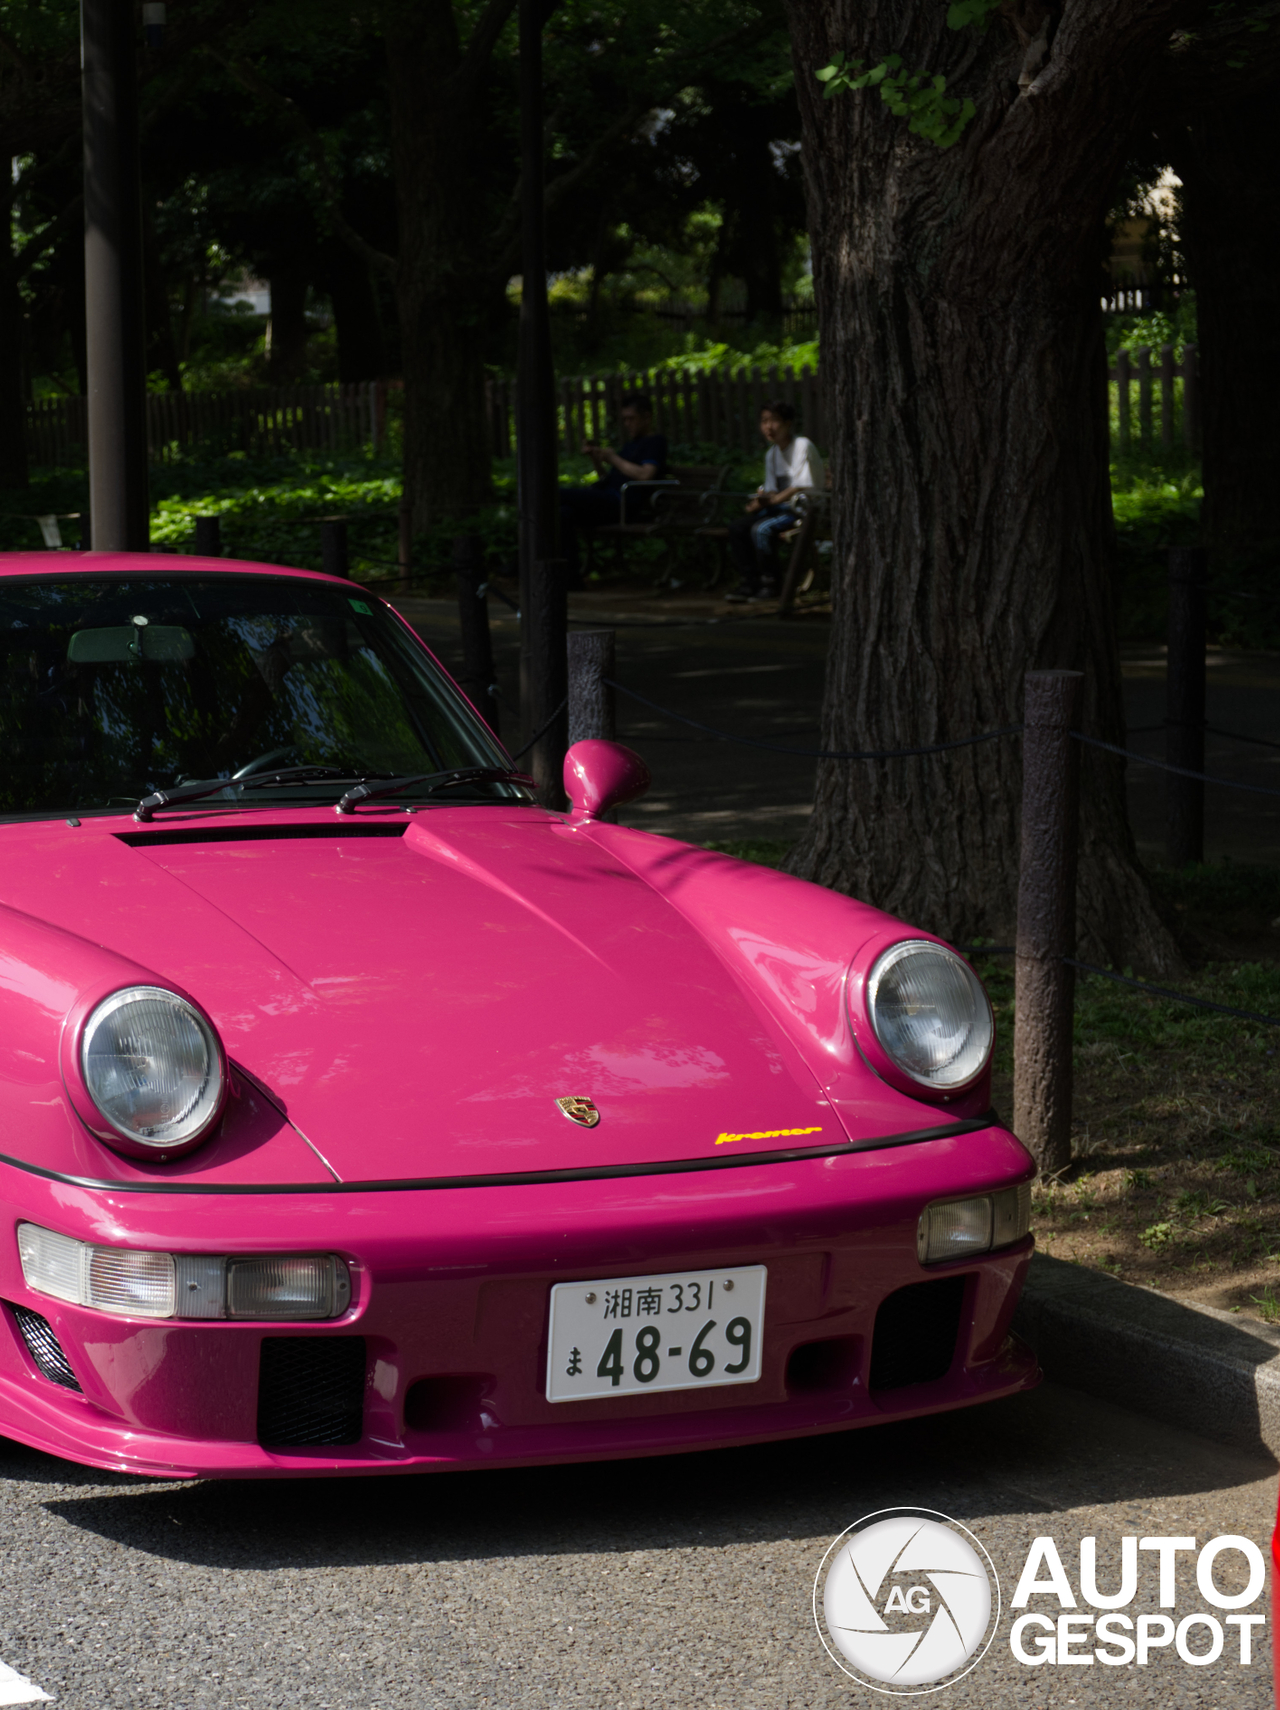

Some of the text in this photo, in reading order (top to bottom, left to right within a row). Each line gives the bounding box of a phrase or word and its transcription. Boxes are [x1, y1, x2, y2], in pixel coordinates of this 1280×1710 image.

[603, 1280, 714, 1319] 湘南331
[565, 1316, 752, 1387] ま 48-69
